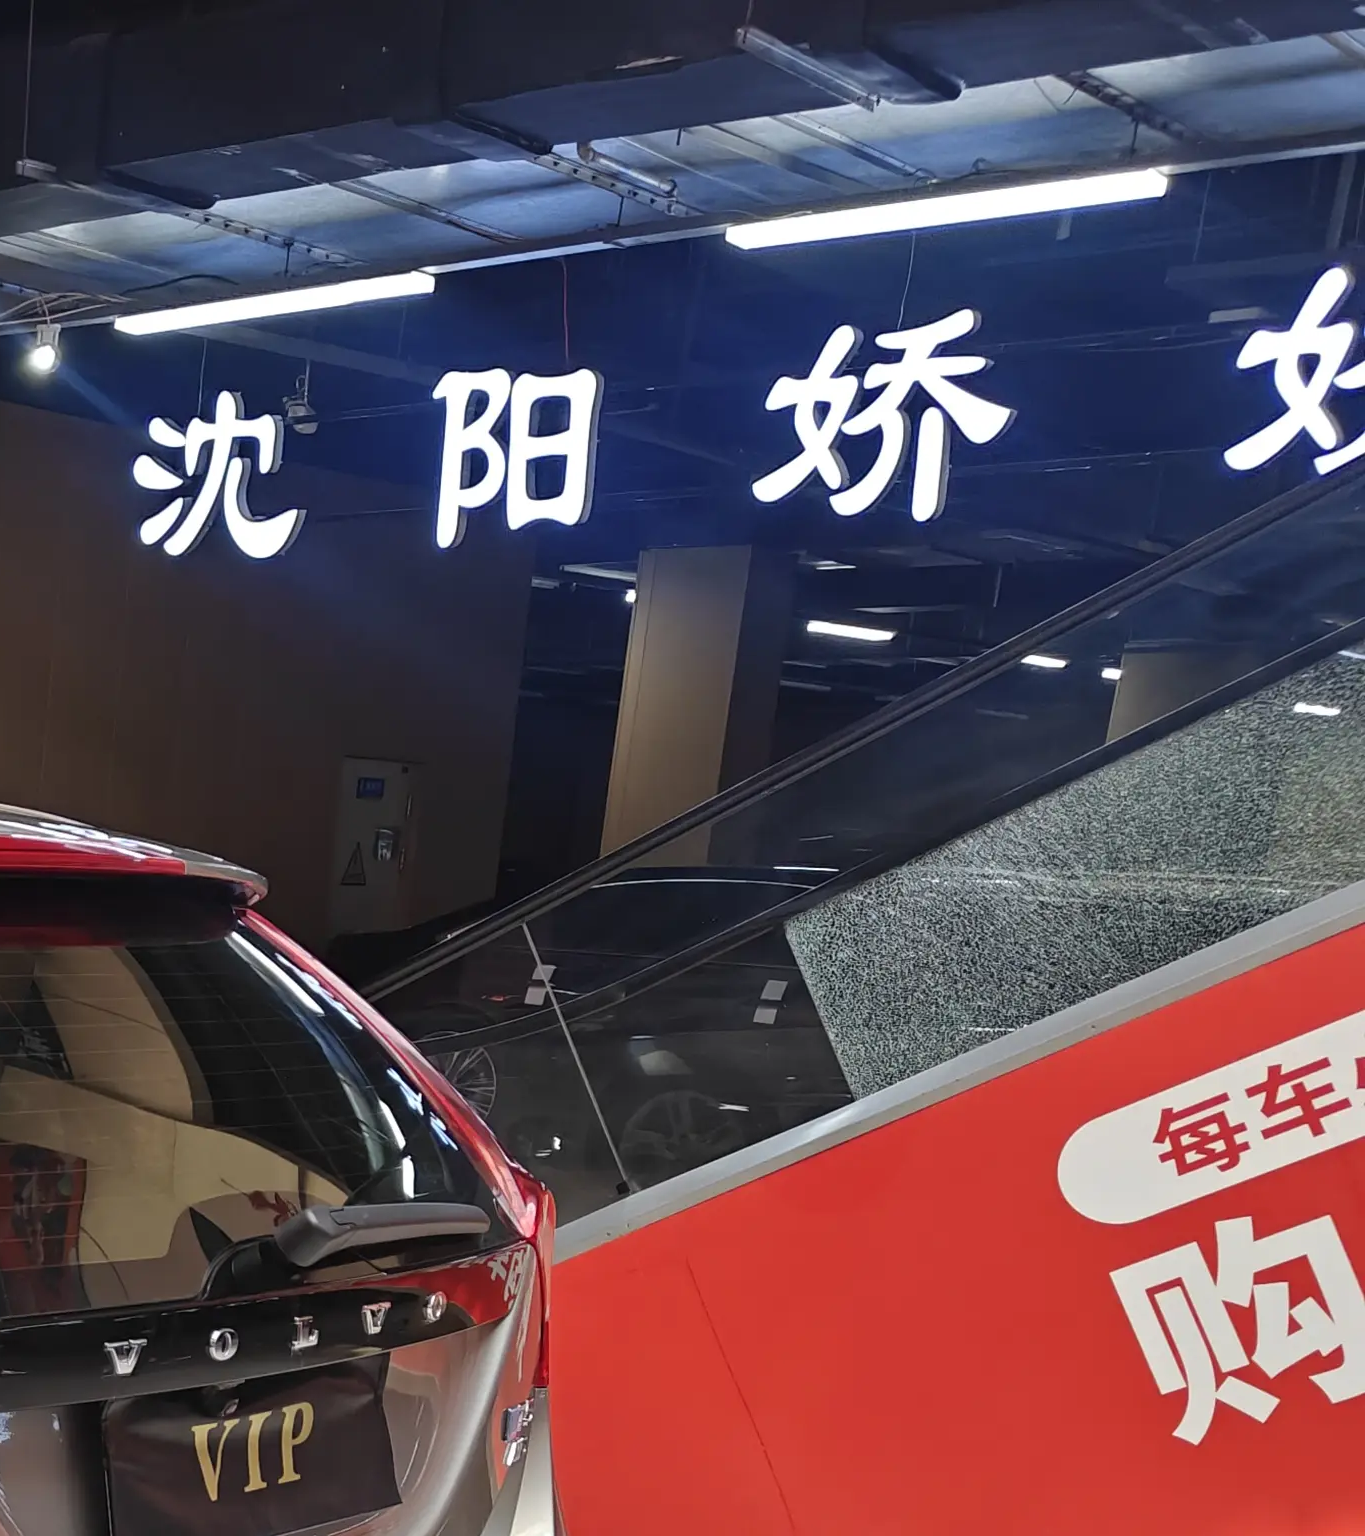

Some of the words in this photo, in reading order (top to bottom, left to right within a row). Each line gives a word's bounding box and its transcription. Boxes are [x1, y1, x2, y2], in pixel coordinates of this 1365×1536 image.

[1153, 1056, 1365, 1177] 每车
[103, 1290, 448, 1378] VOLVO
[190, 1400, 316, 1503] VIP
